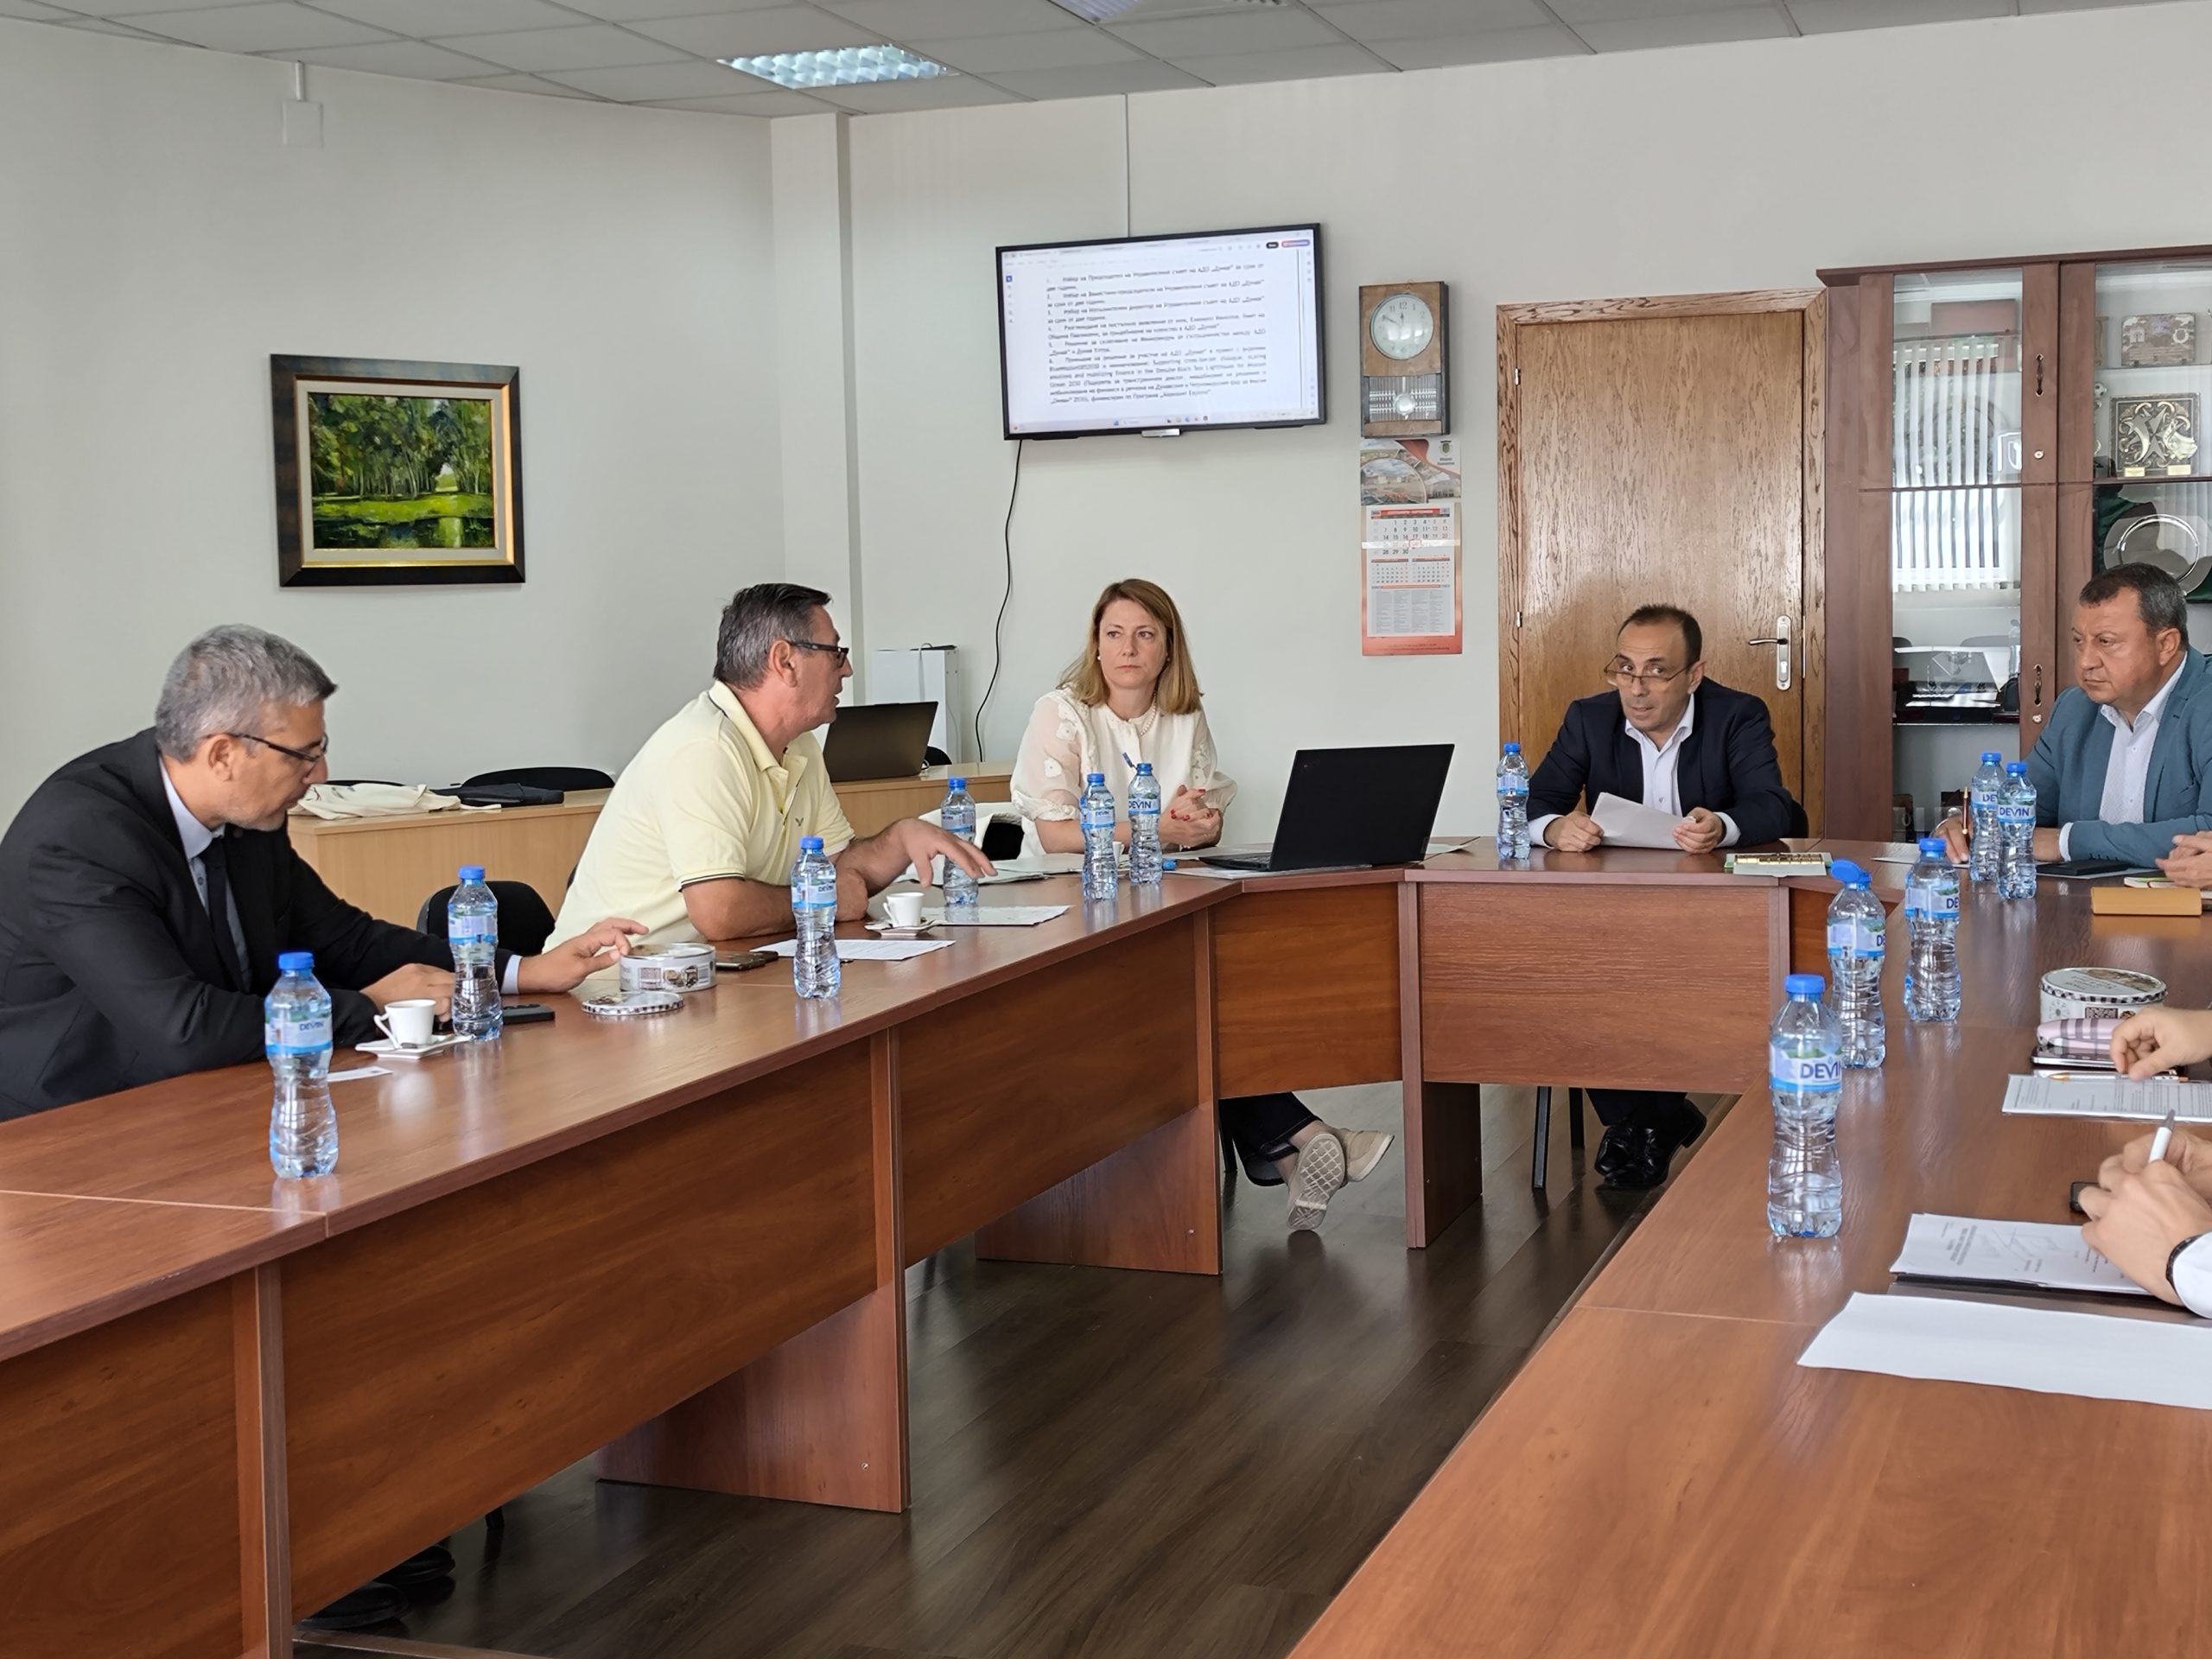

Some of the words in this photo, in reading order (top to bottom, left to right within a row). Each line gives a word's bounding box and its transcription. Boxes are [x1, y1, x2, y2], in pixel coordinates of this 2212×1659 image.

[1399, 302, 1408, 310] 12
[2000, 807, 2030, 817] DEVIN
[1800, 1060, 1841, 1079] DEVI
